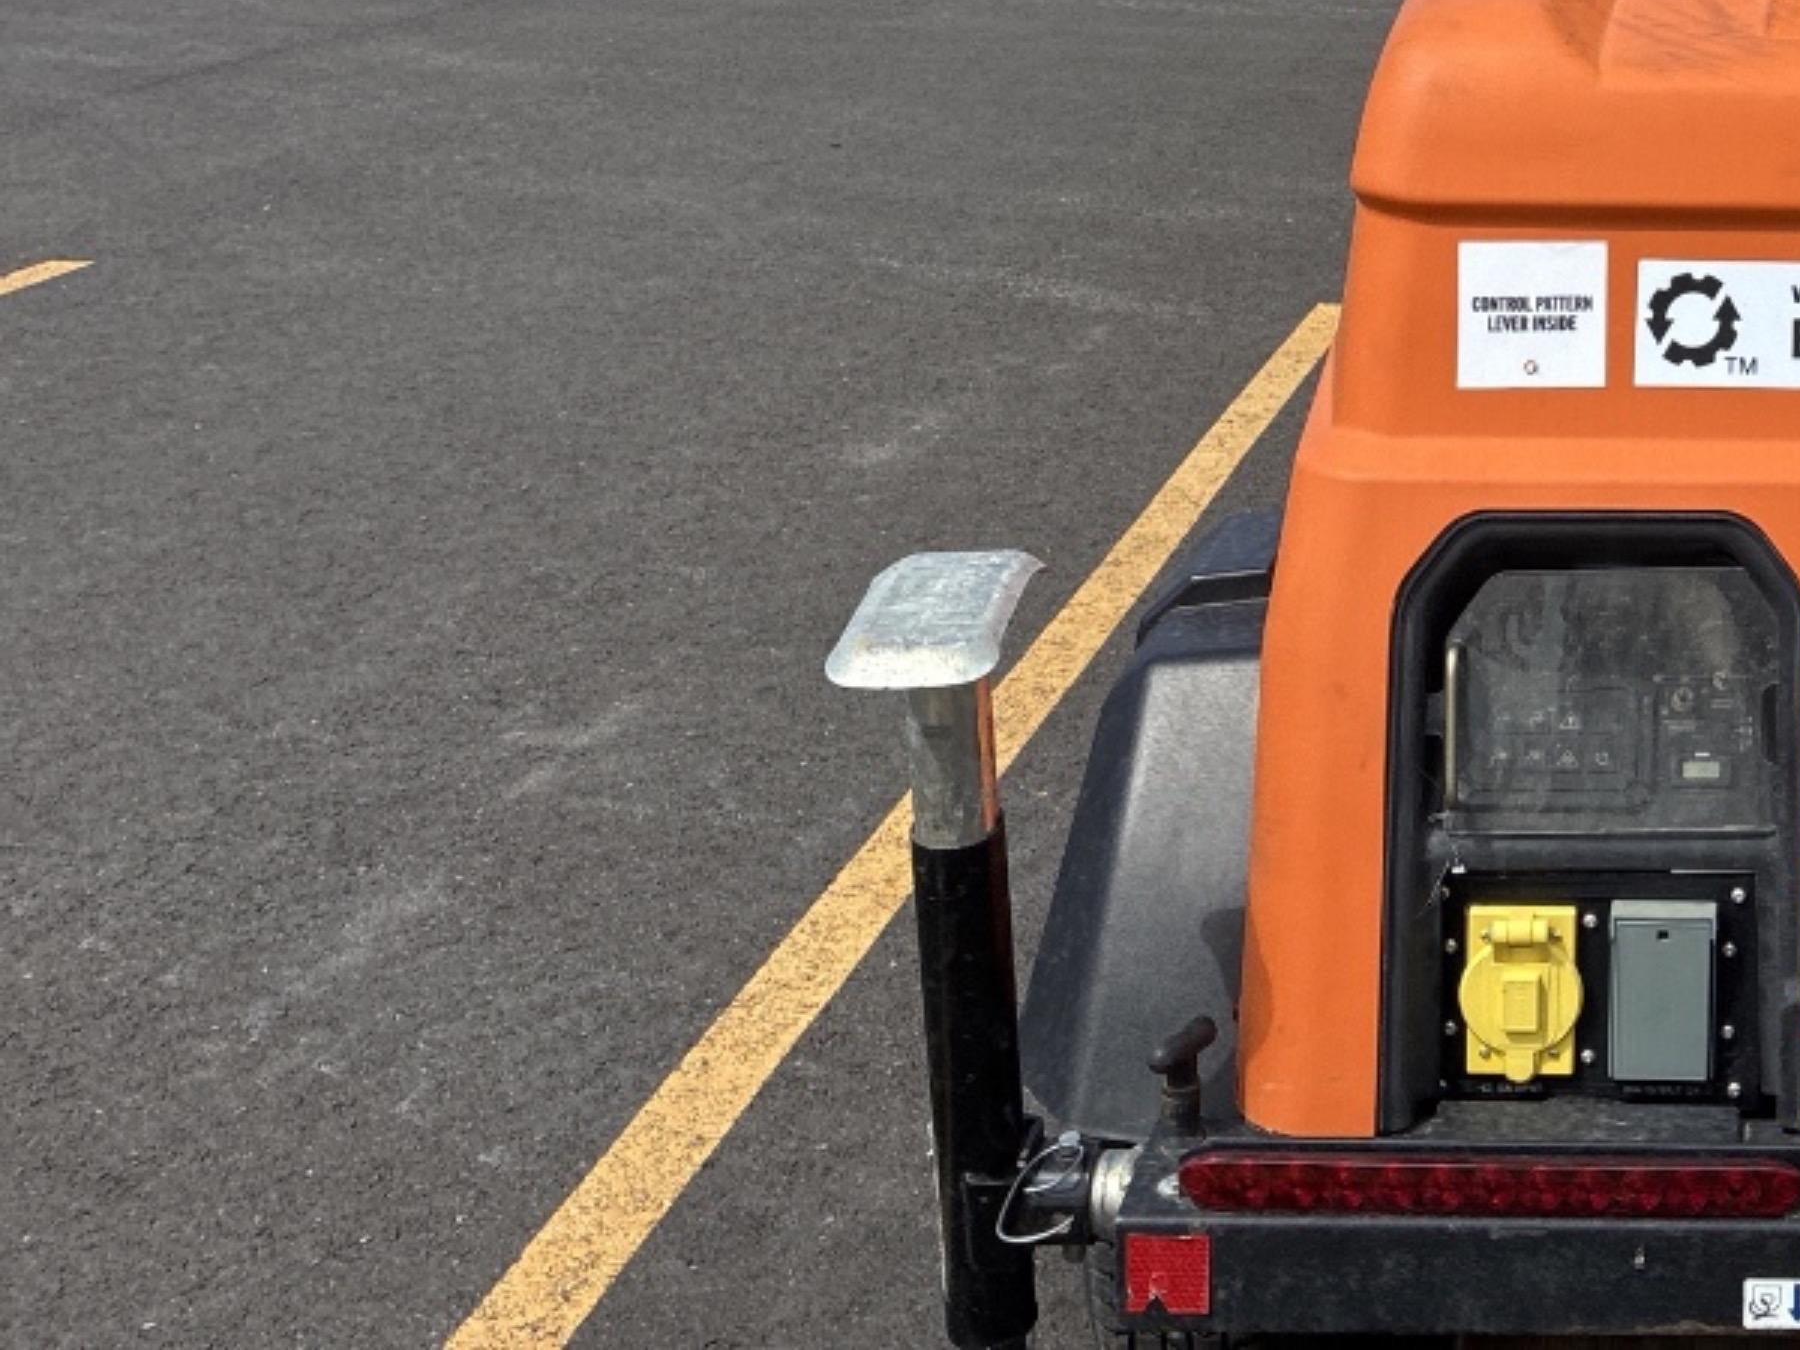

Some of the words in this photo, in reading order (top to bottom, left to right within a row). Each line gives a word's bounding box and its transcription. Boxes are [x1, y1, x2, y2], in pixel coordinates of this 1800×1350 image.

[1471, 295, 1533, 313] CONTROL
[1535, 295, 1594, 312] PATTERN
[1487, 314, 1528, 333] LEVER
[1532, 314, 1577, 332] INSIDE
[1724, 356, 1759, 376] TM
